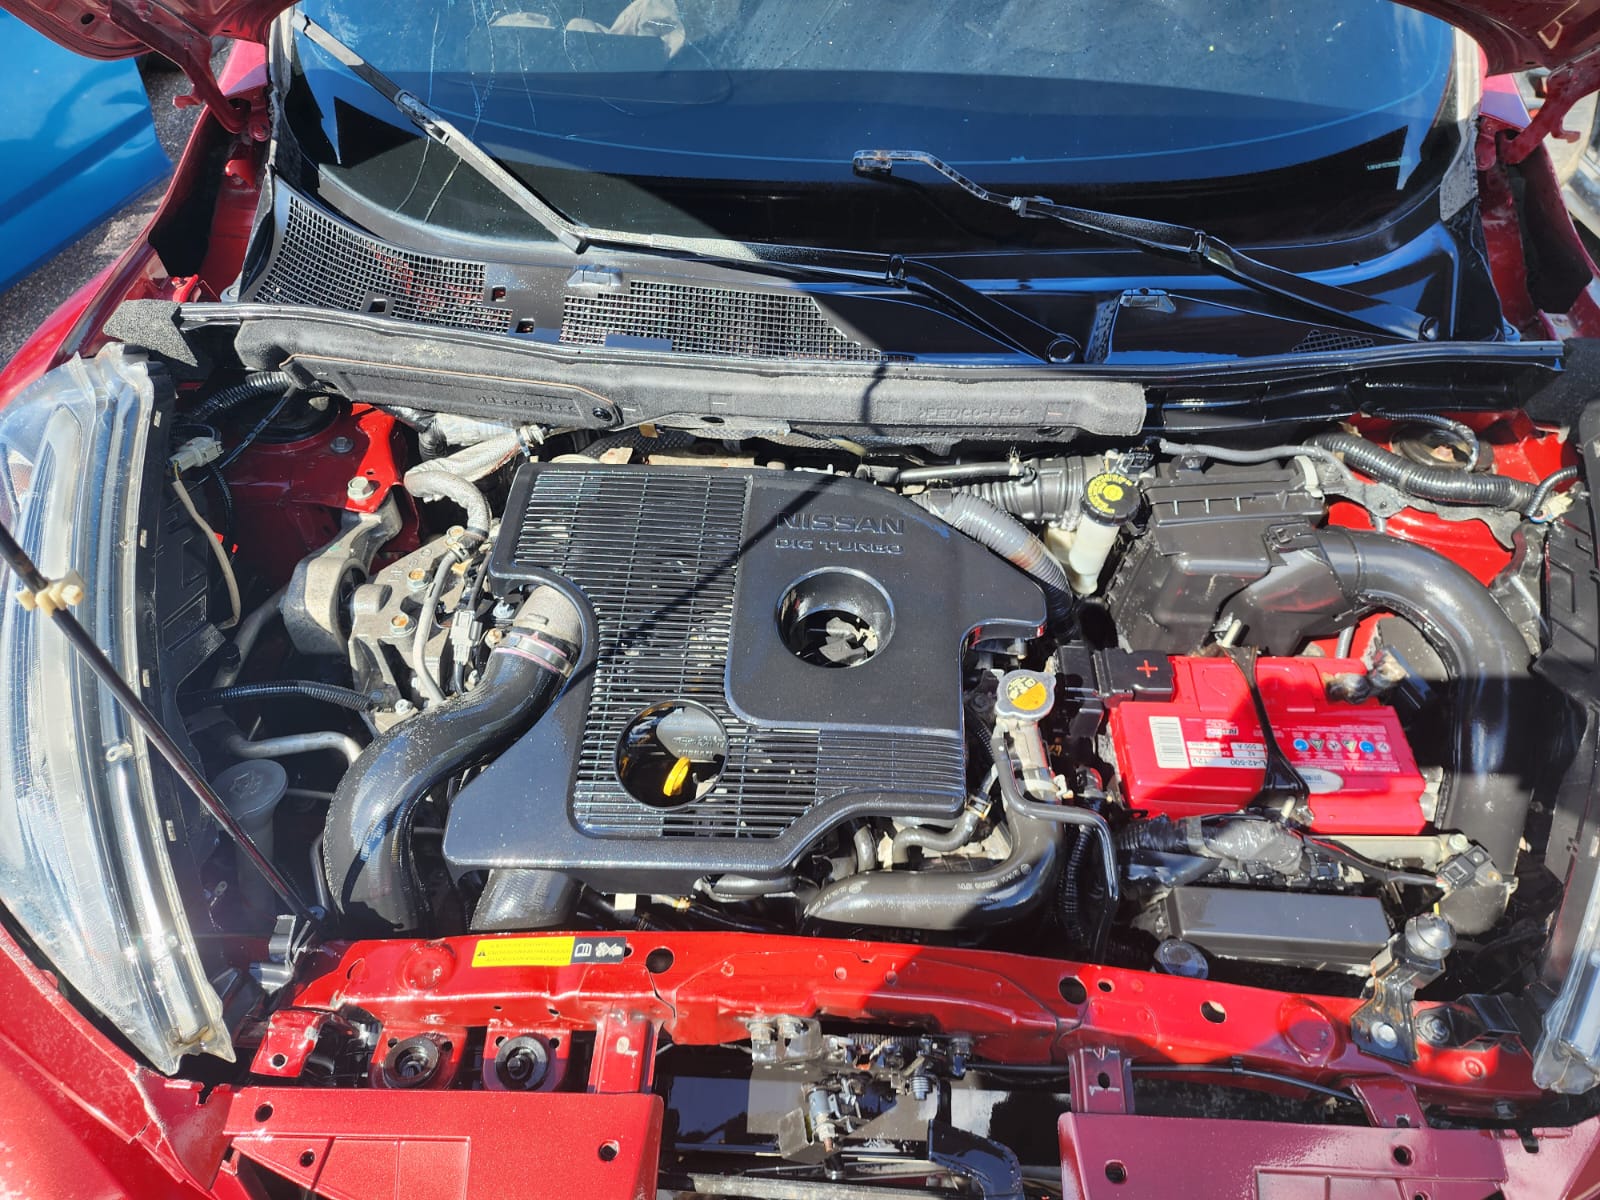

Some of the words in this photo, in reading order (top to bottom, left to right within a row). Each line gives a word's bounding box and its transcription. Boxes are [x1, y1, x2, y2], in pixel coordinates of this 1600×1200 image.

[775, 511, 905, 535] NISSAN
[774, 537, 814, 550] DIG
[819, 540, 904, 555] TURBO
